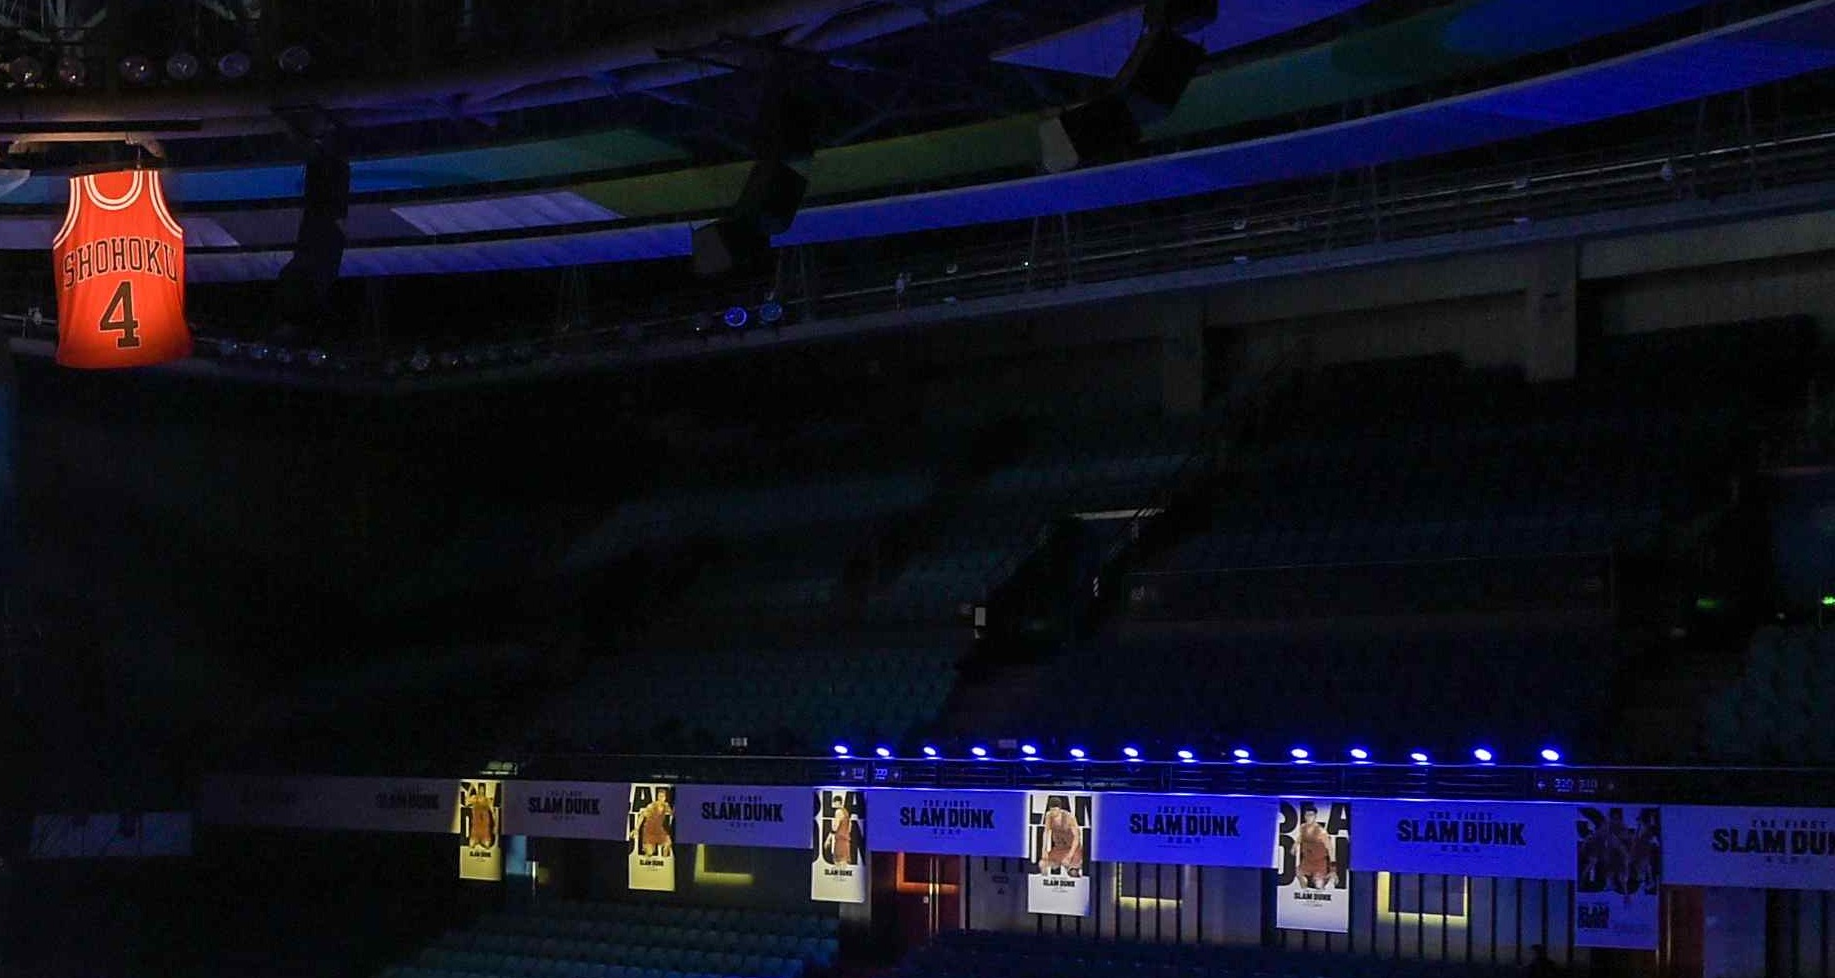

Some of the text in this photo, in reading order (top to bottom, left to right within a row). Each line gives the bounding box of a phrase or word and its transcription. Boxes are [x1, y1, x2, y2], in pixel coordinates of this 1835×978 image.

[63, 236, 178, 289] SHOHOKU
[99, 280, 141, 349] 4
[528, 797, 600, 815] SLAM DUNK
[701, 802, 784, 822] SLAM DUNK
[900, 807, 995, 829] SLAM DUNK
[1130, 813, 1240, 837] SLAM DUNK
[1397, 819, 1527, 846] SLAM DUNK
[1712, 828, 1786, 853] SLAM
